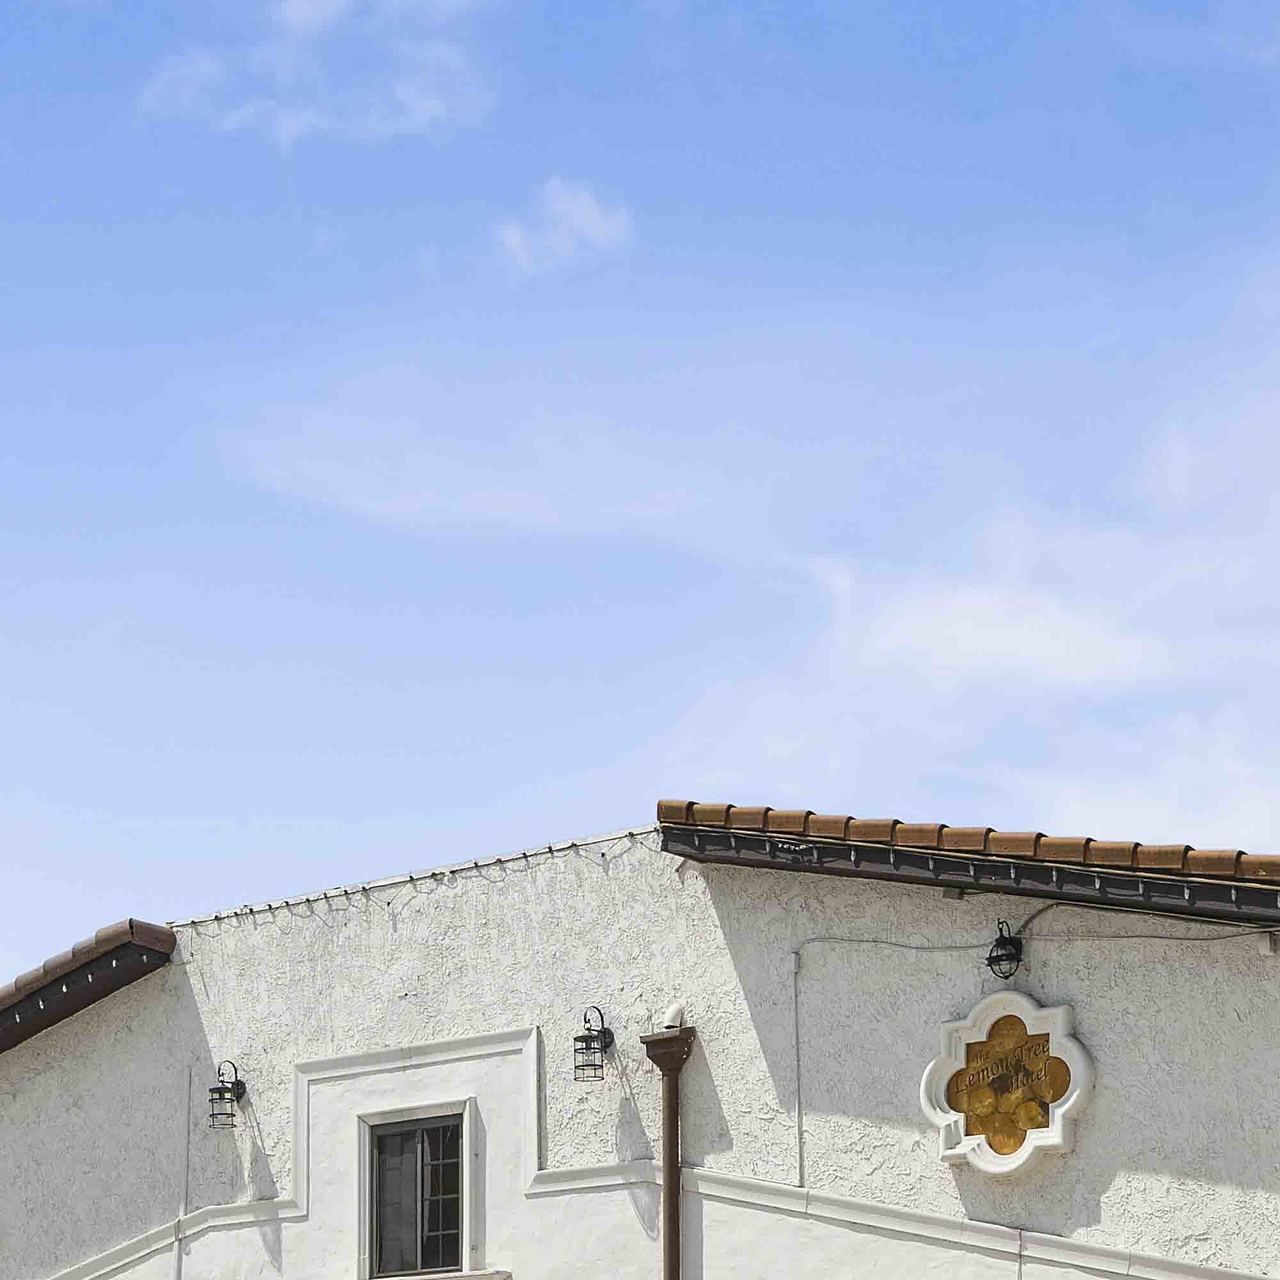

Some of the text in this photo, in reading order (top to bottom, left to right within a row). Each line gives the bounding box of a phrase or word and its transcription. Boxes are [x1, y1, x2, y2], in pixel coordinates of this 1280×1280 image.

[955, 1039, 1050, 1095] Lemon Tree
[1008, 1058, 1050, 1094] Hotel
